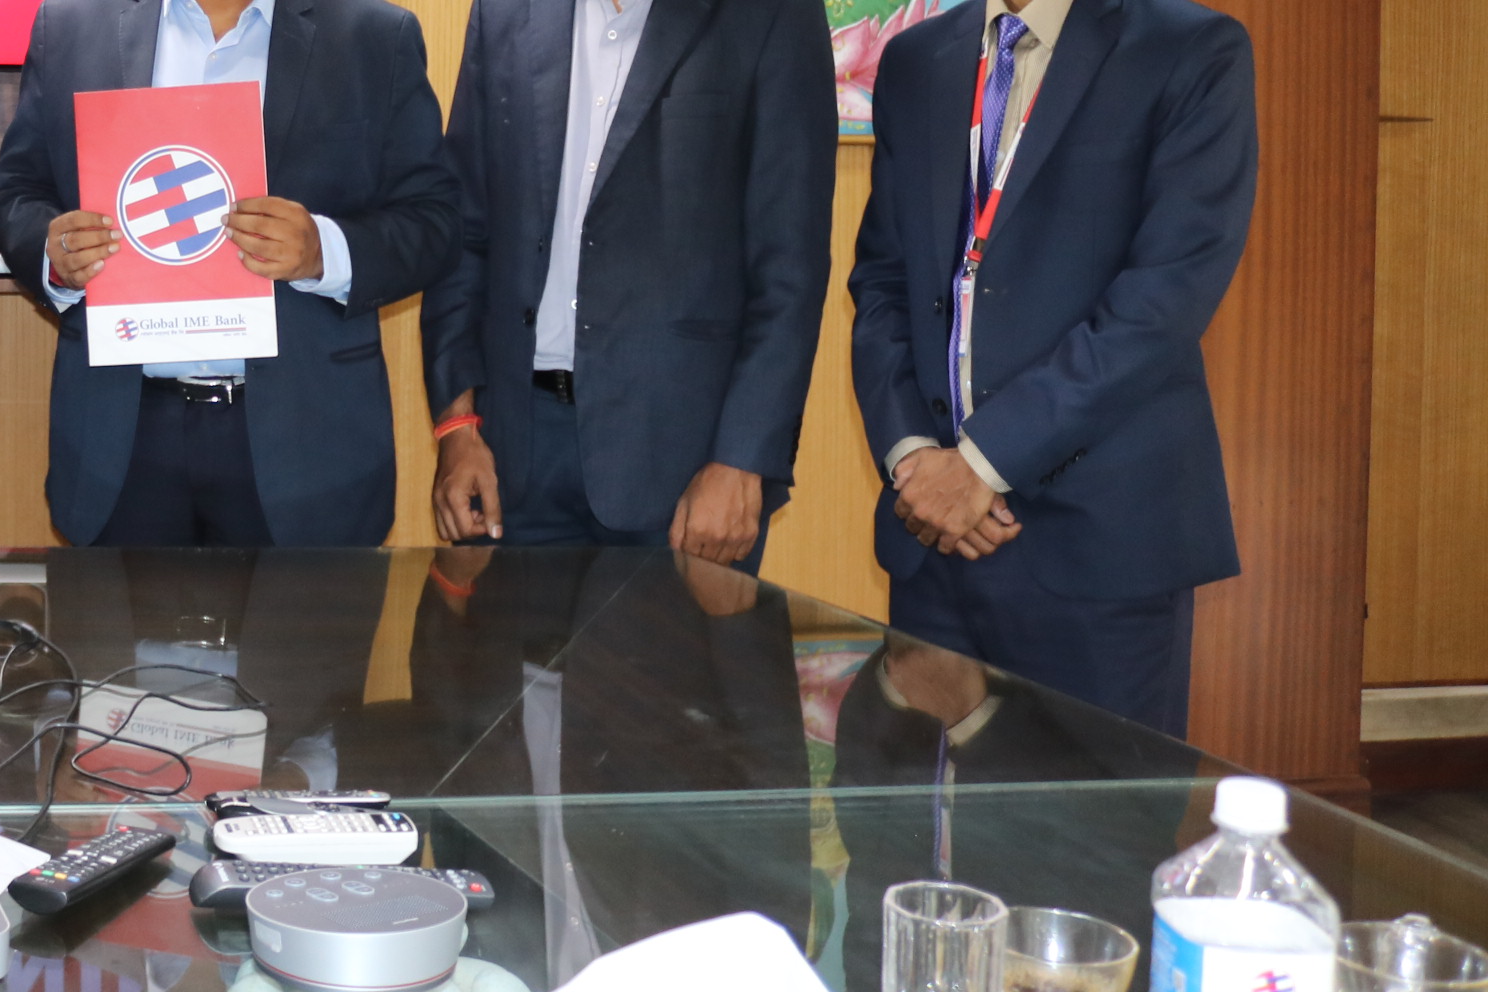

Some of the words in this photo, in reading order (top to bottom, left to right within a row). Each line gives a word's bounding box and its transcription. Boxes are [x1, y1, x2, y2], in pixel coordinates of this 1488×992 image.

[140, 317, 179, 331] Global
[184, 315, 209, 328] IME
[215, 314, 246, 326] Bank
